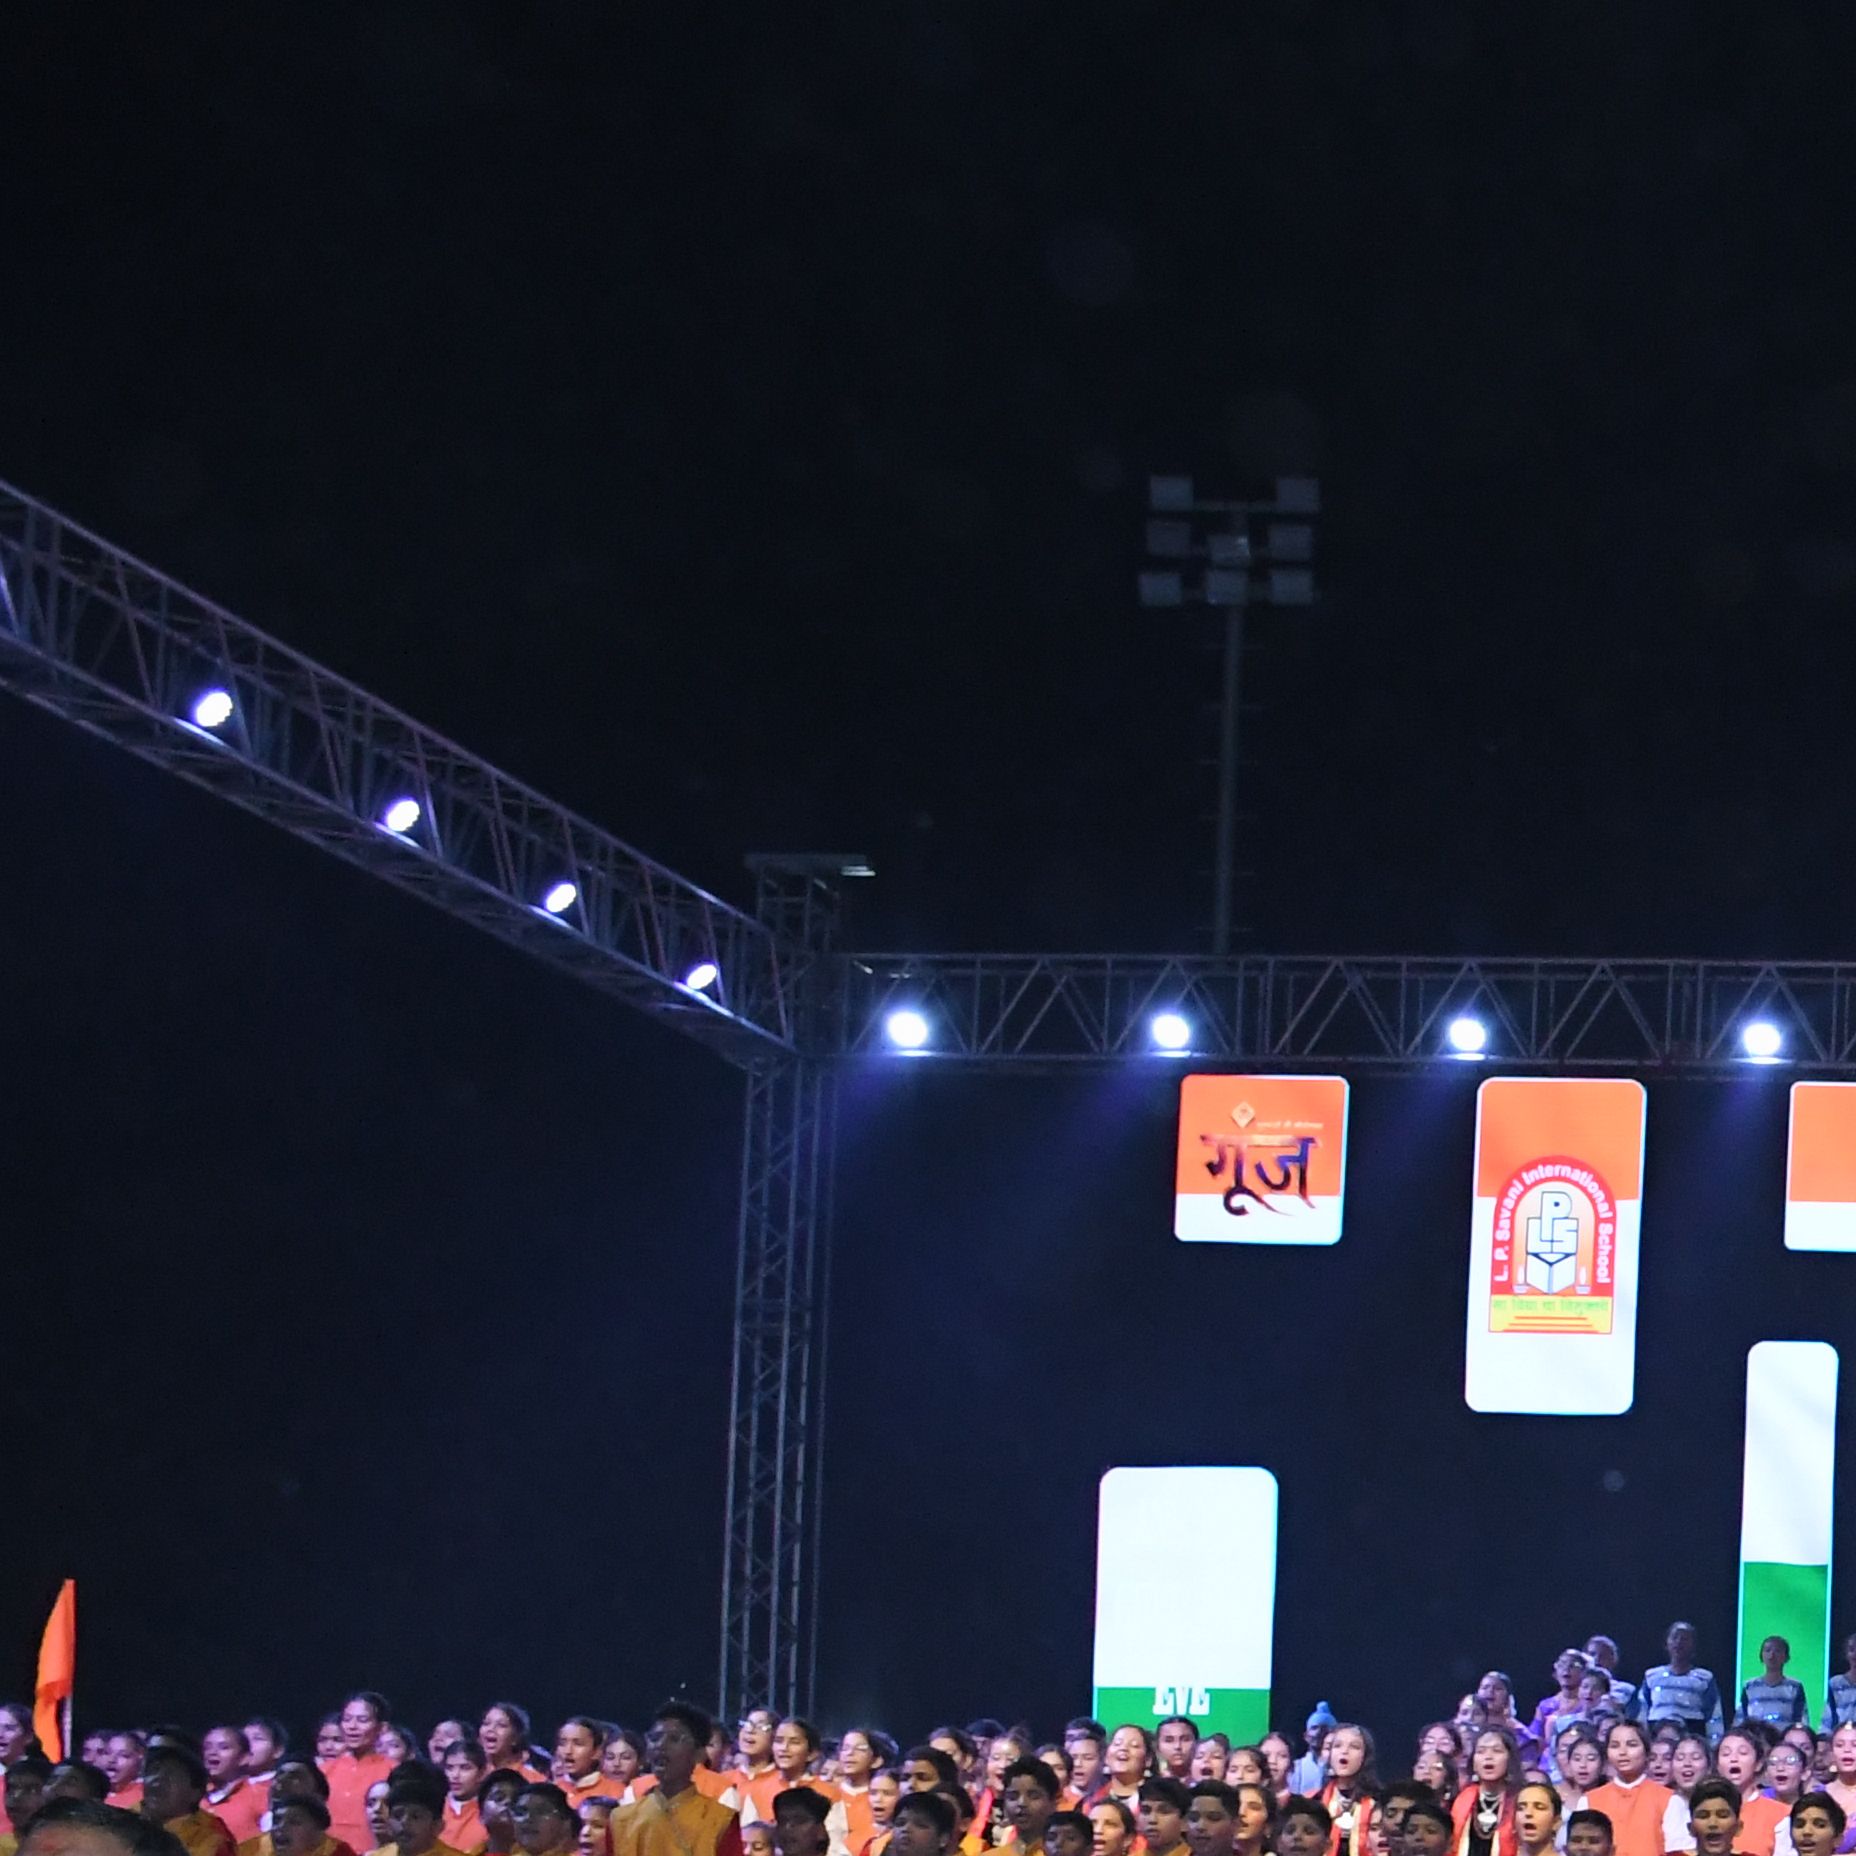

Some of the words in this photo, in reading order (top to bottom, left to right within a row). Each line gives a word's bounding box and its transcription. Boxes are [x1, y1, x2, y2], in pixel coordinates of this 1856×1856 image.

[1495, 1179, 1525, 1241] Savani
[1522, 1164, 1613, 1219] International
[1597, 1222, 1613, 1283] School
